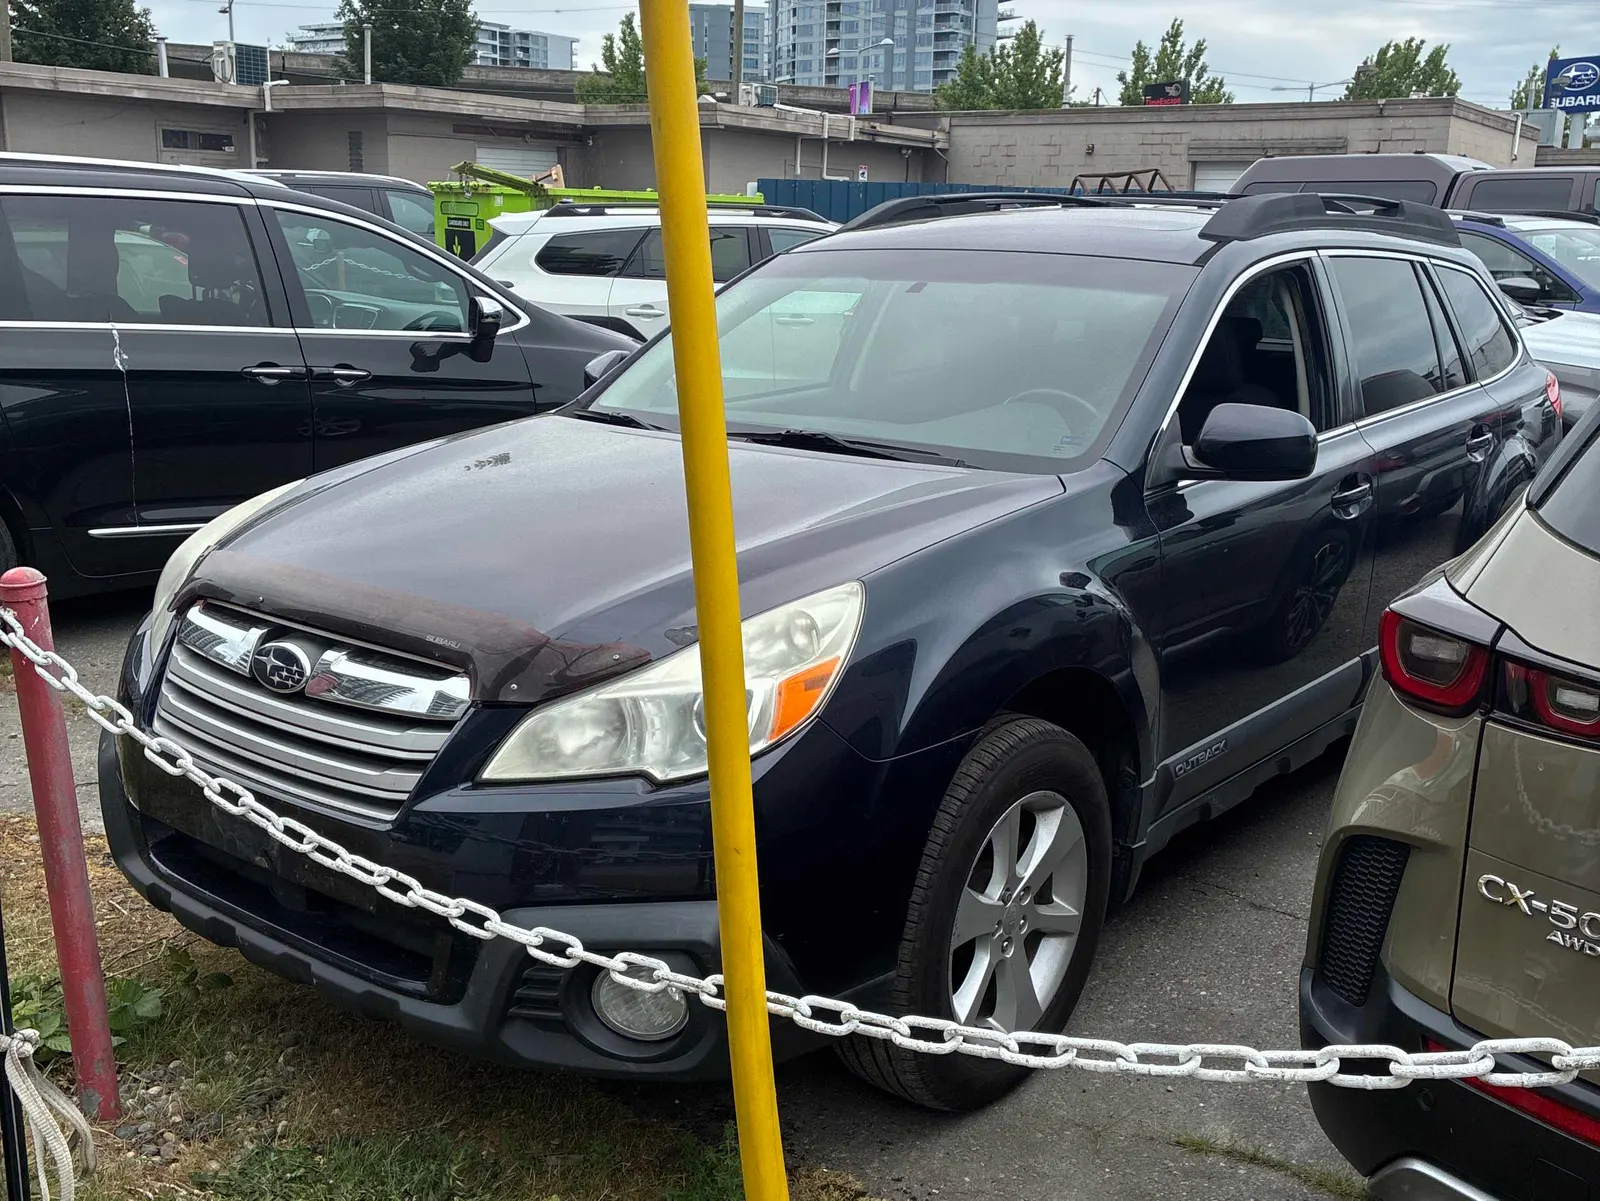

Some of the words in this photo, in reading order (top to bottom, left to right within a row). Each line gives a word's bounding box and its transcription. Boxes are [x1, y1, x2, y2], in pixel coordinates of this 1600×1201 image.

[425, 634, 461, 649] SUBARU
[1175, 739, 1227, 776] OUTBACK
[1545, 930, 1600, 957] AWD
